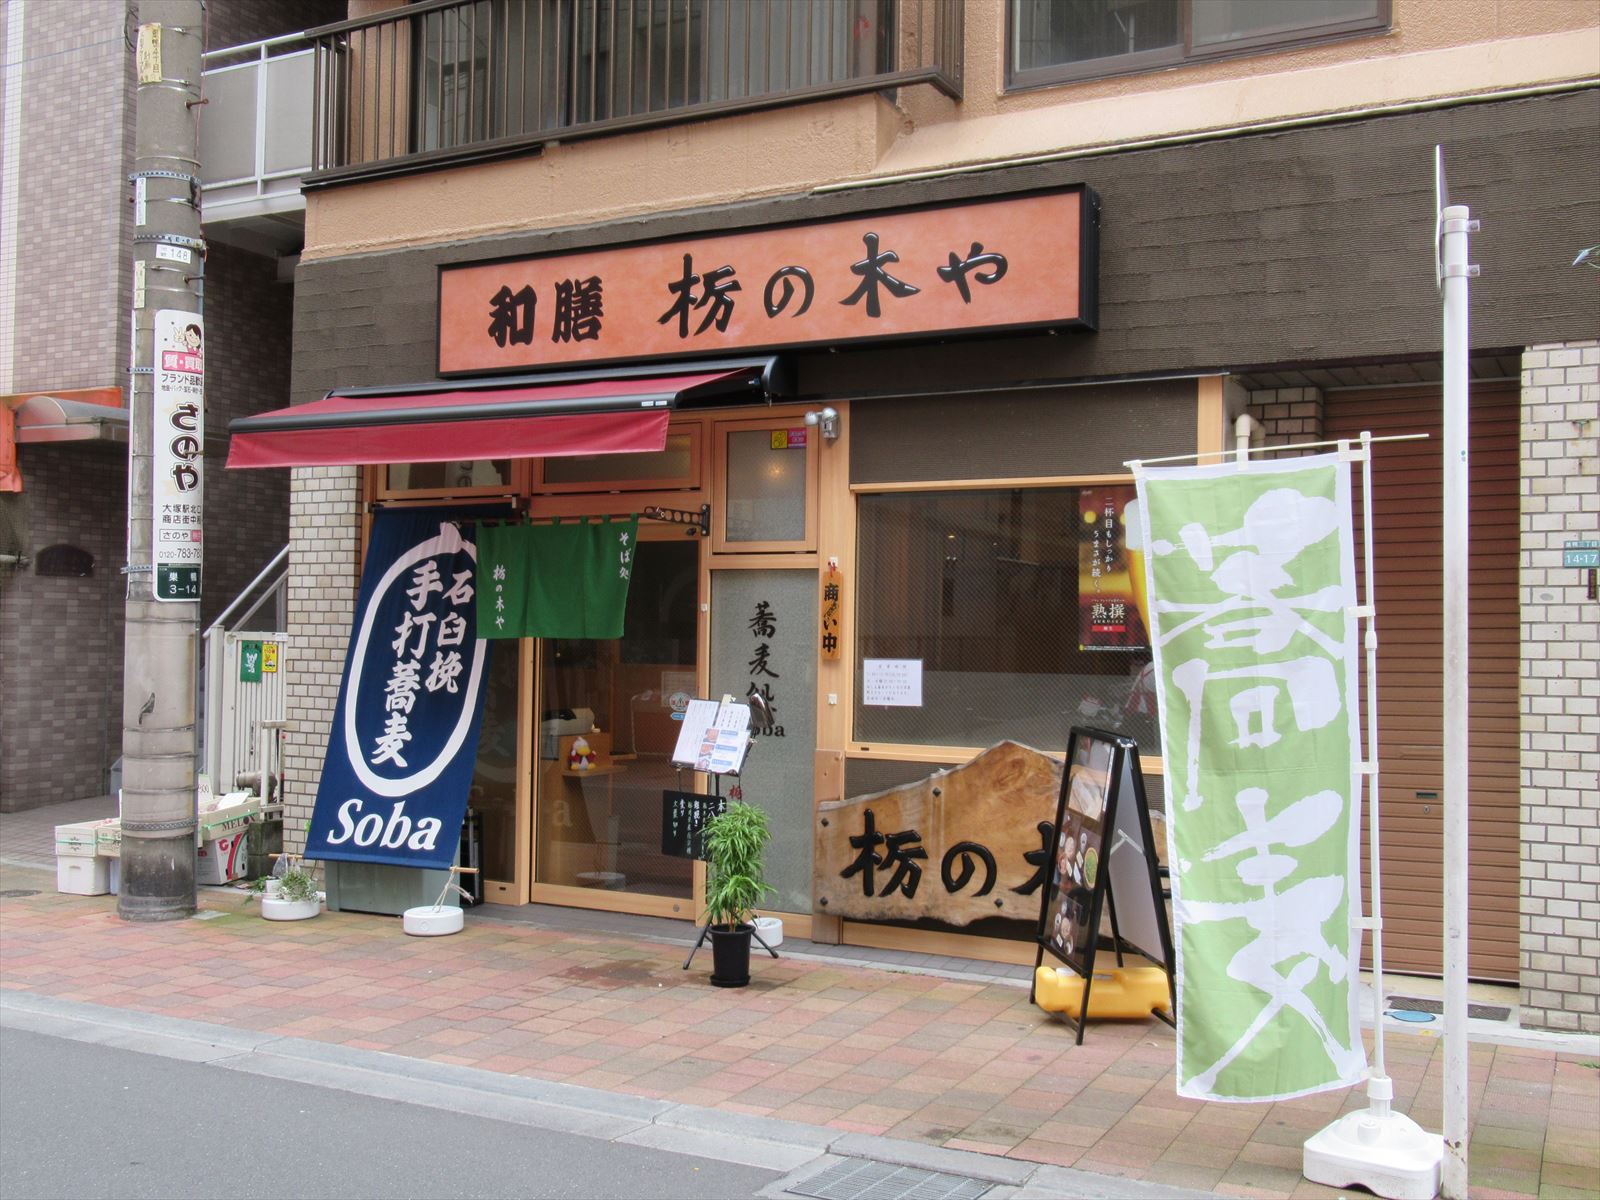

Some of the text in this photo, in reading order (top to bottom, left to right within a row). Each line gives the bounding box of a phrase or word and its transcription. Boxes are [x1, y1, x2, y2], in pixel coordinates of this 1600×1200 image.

[171, 248, 188, 261] 148
[487, 232, 1009, 348] 和膳 栃の木や
[171, 403, 199, 491] さのや
[162, 531, 189, 540] さのや
[619, 531, 632, 580] そば処
[169, 584, 197, 595] 3-14
[492, 564, 506, 630] 栃の木や
[370, 559, 444, 768] 手打蕎麦
[424, 568, 475, 694] 石臼挽
[1152, 486, 1352, 1092] 蕎麦
[326, 798, 442, 850] Soba
